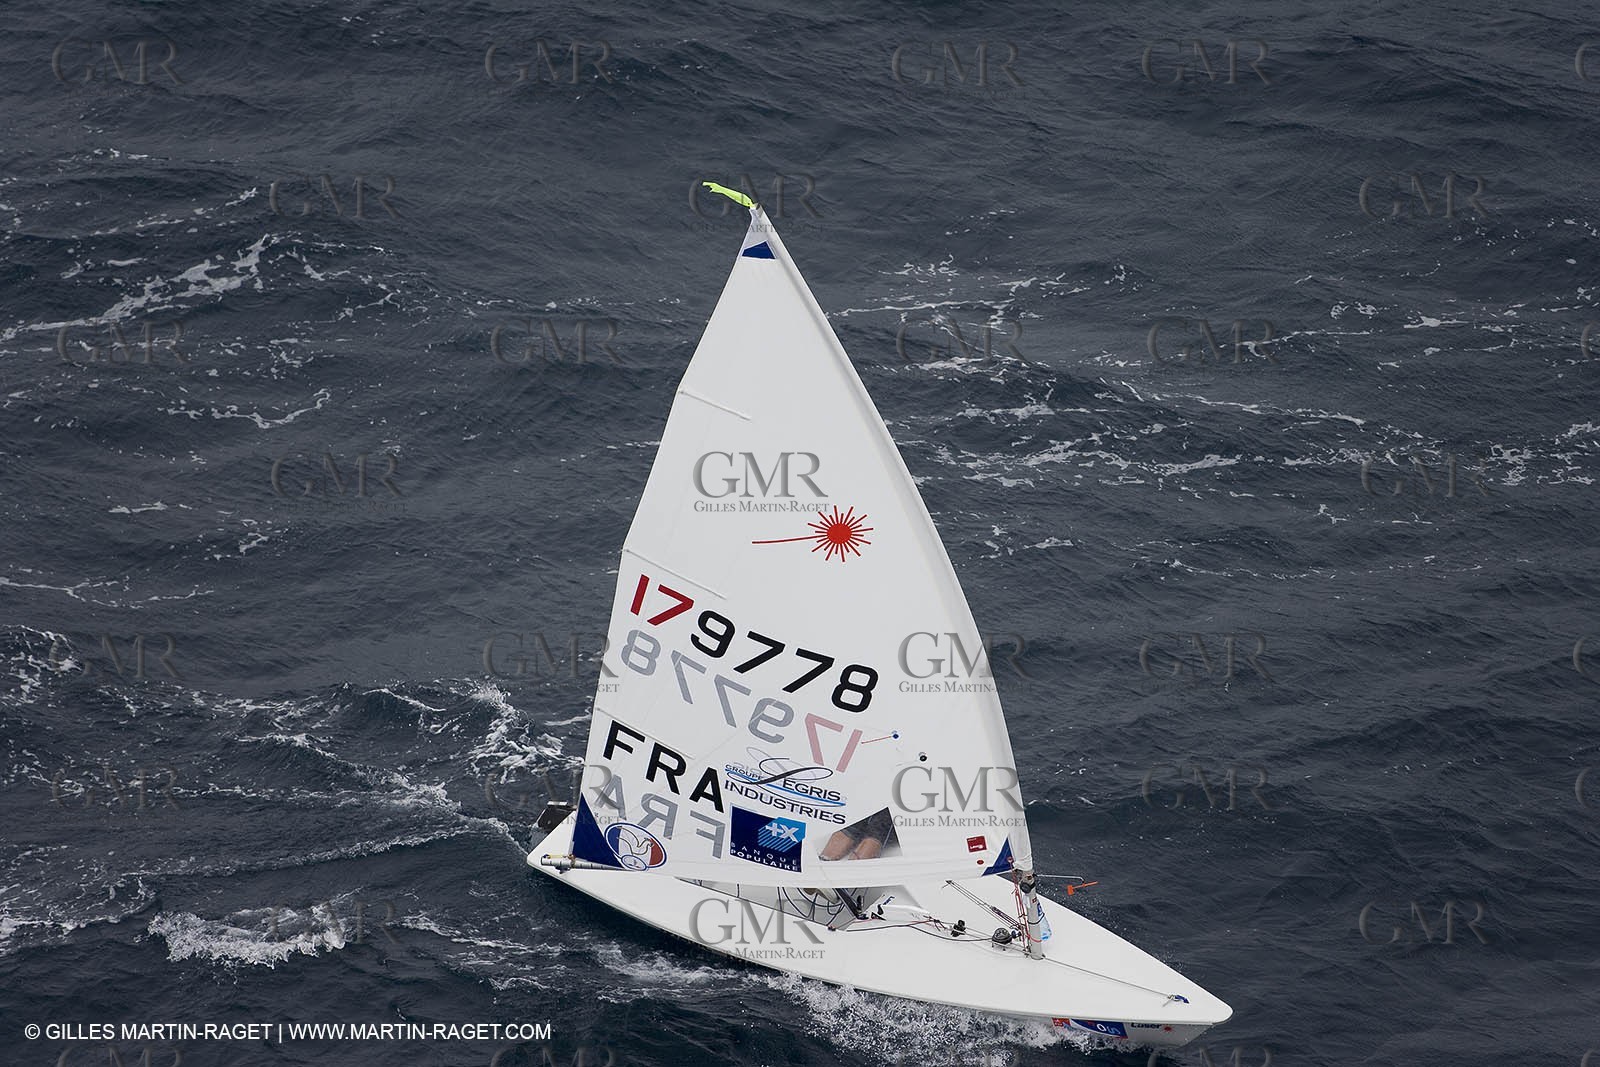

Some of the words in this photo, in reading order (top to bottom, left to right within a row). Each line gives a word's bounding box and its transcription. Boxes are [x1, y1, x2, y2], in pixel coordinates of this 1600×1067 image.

[630, 574, 878, 713] 179778
[603, 720, 724, 813] FRA
[725, 764, 764, 781] GROUPE
[724, 780, 846, 825] INDUSTRIES
[730, 842, 797, 865] BANQUE
[730, 849, 798, 871] POPULAIRE
